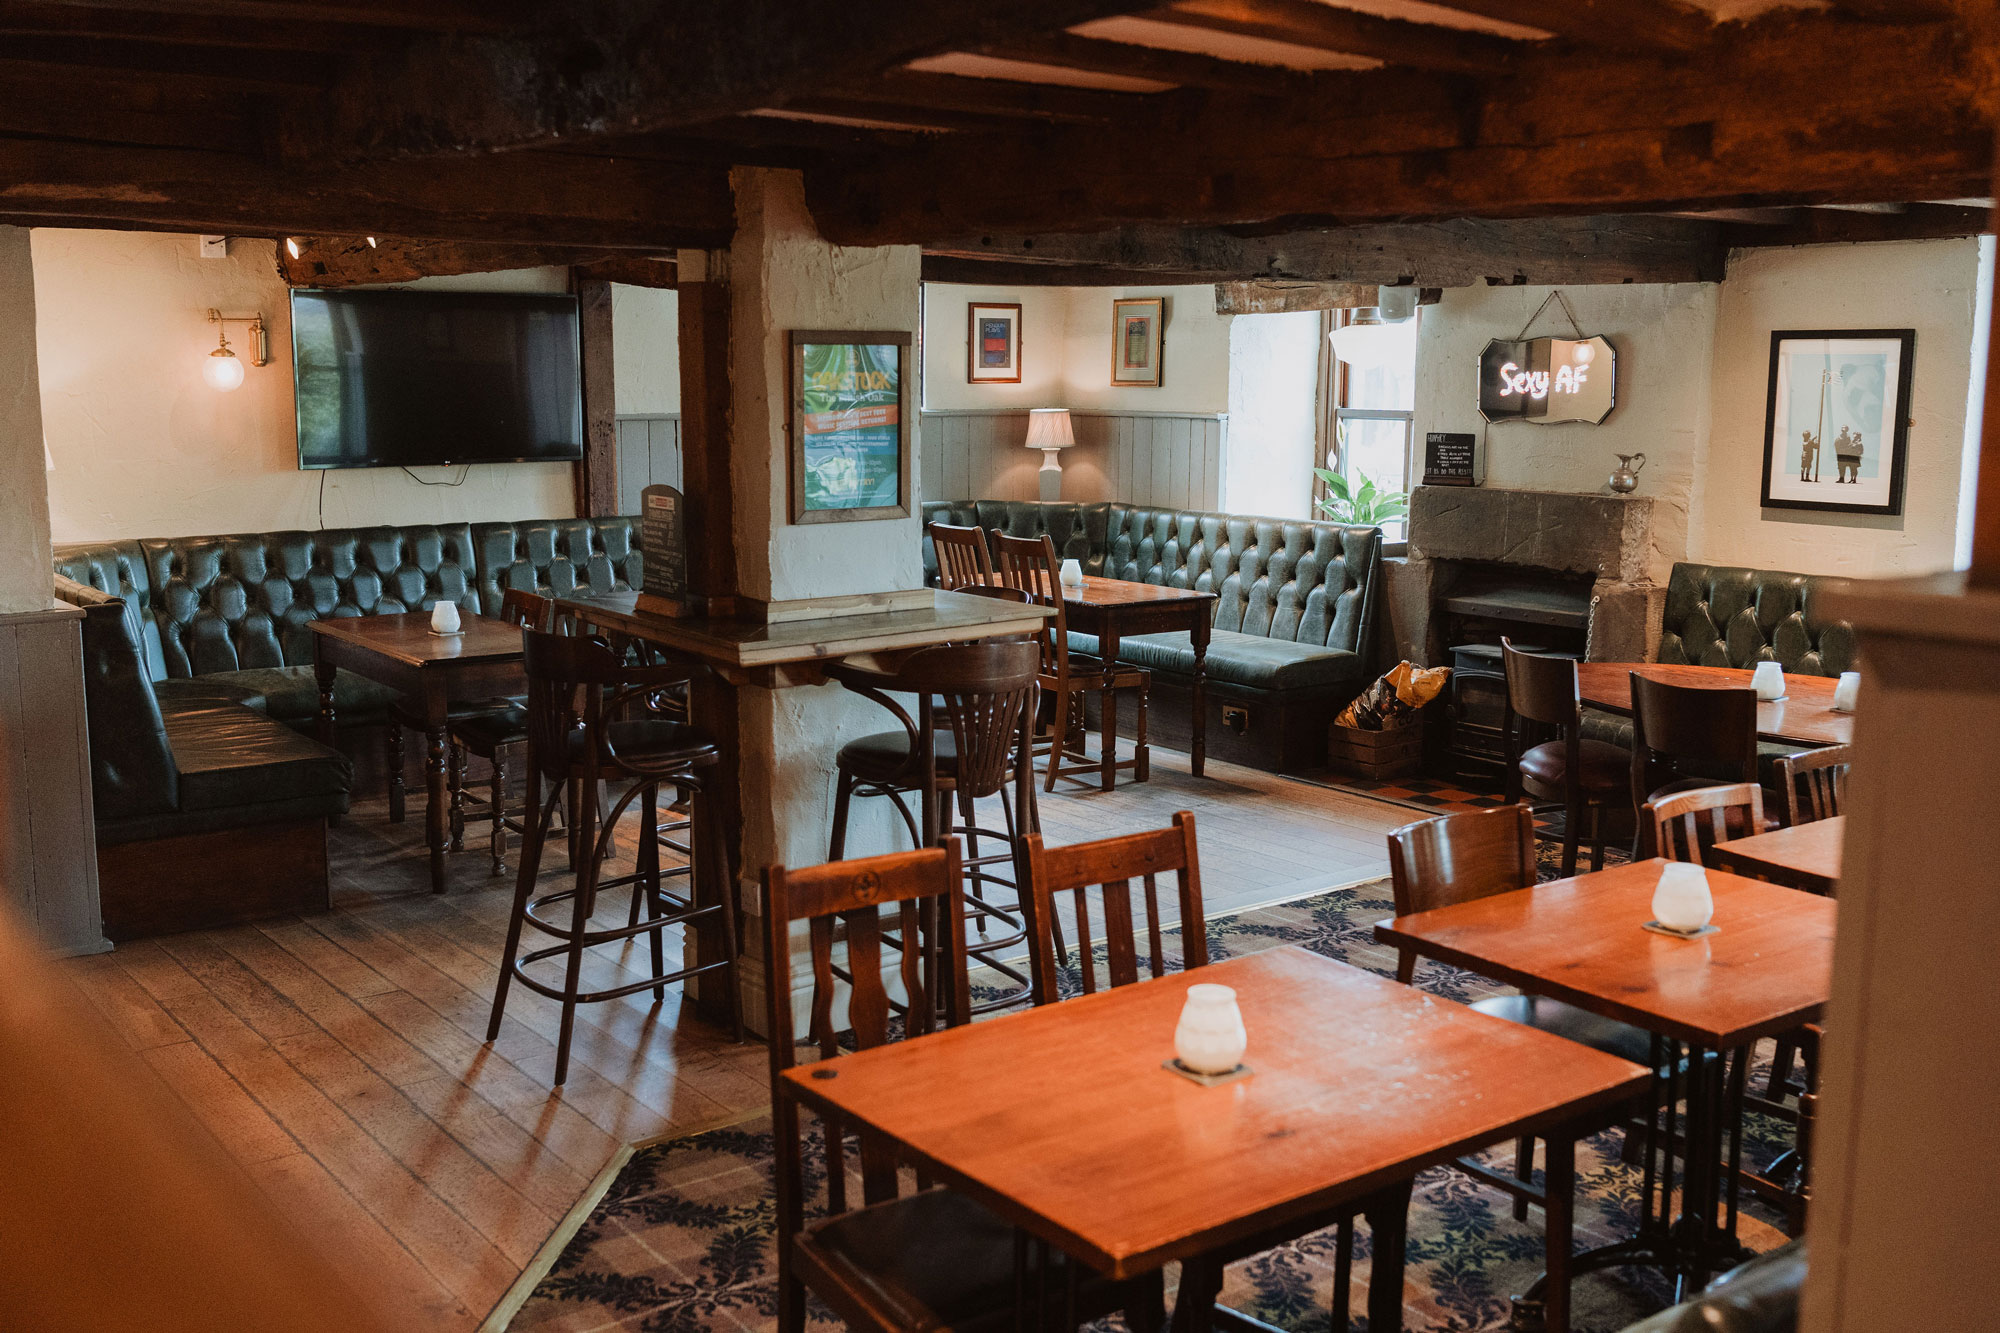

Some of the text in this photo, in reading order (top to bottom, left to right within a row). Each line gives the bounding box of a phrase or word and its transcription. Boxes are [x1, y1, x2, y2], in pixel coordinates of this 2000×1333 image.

[812, 371, 891, 391] OAKSTOCK
[1500, 362, 1590, 399] Sexy AF
[821, 393, 837, 402] The
[867, 392, 885, 402] Oak
